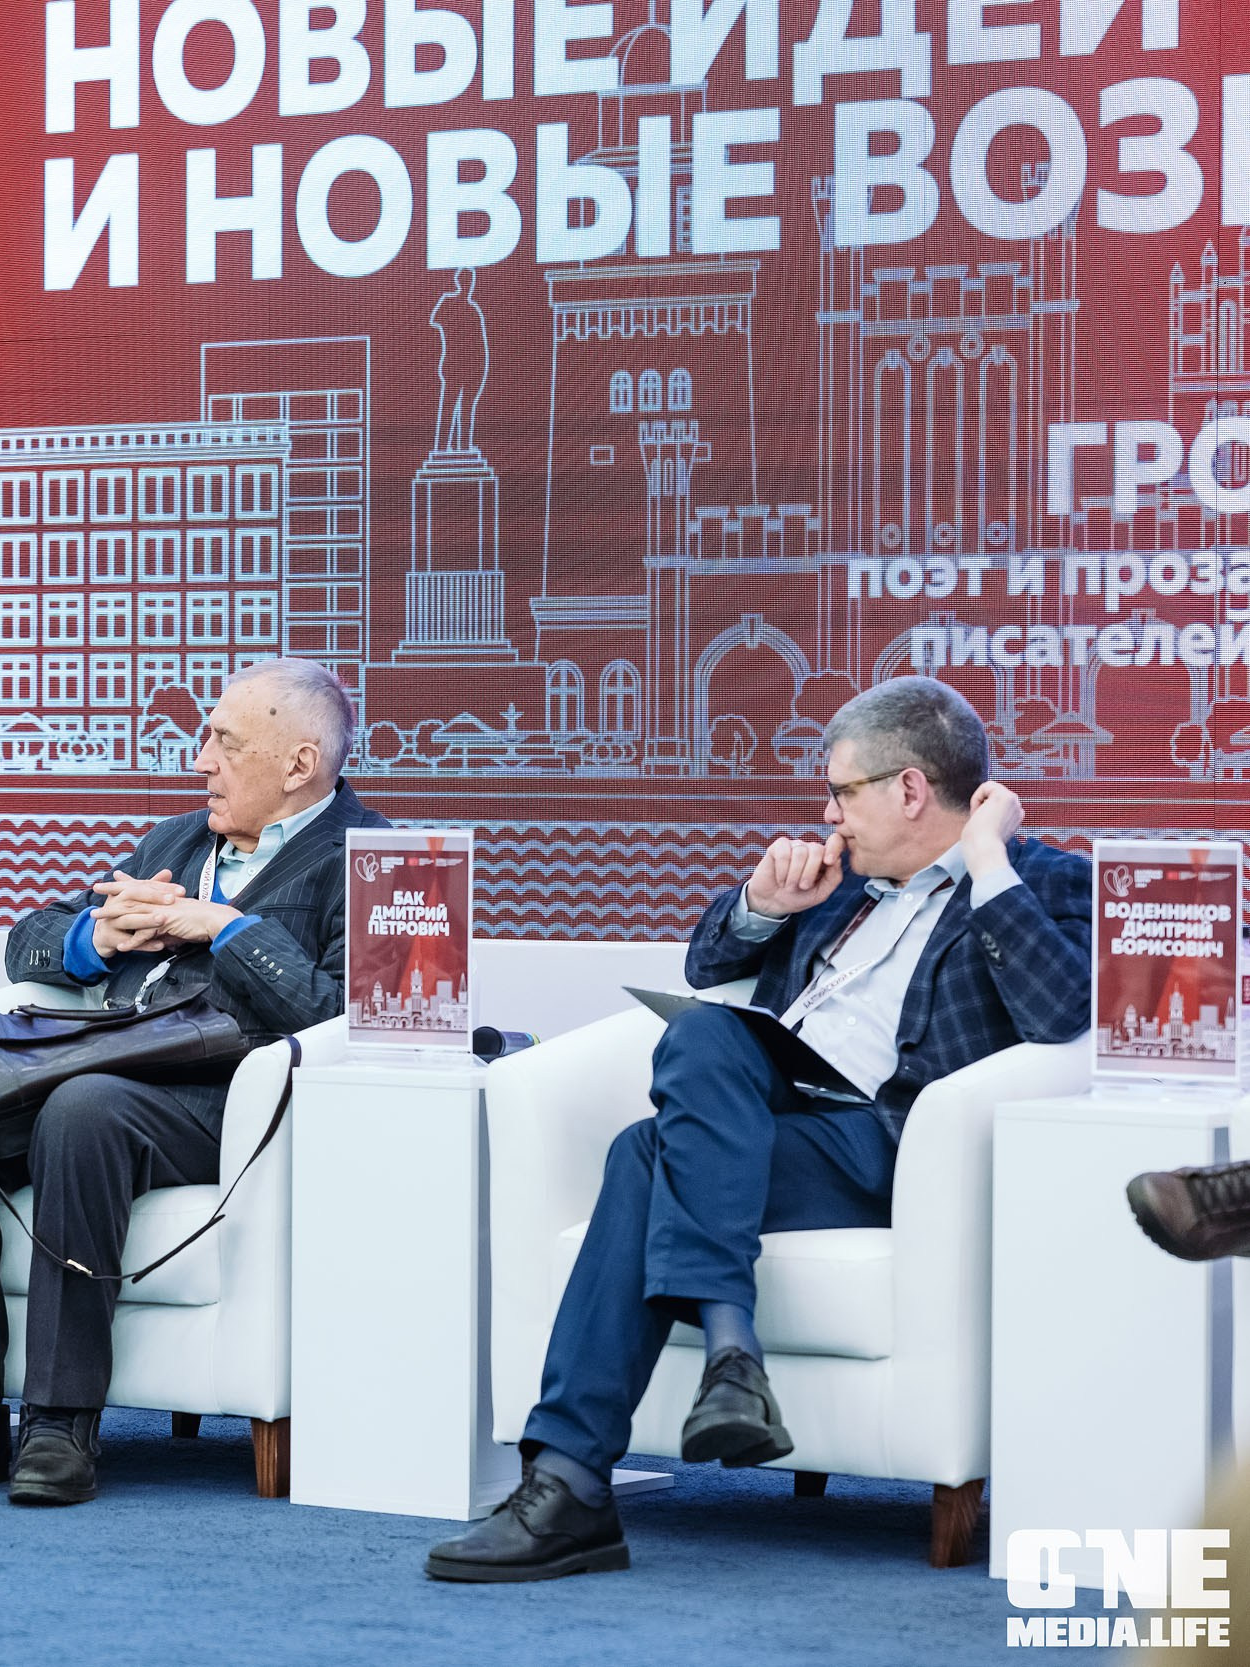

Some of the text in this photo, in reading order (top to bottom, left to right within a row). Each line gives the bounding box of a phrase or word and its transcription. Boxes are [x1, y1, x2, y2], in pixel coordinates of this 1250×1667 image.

[45, 0, 621, 134] НОВЫЕ
[44, 152, 140, 291] И
[186, 107, 781, 284] НОВЫЕ
[848, 556, 992, 599] поэт
[1007, 557, 1045, 596] и
[393, 890, 425, 906] БАК
[369, 904, 448, 922] ДМИТРИЙ
[1104, 901, 1232, 922] ВОДЕННИКОВ
[367, 920, 450, 937] ПЕТРОВИЧ
[1121, 920, 1214, 940] ДМИТРИЙ
[1110, 938, 1224, 959] БОРИСОВИЧ
